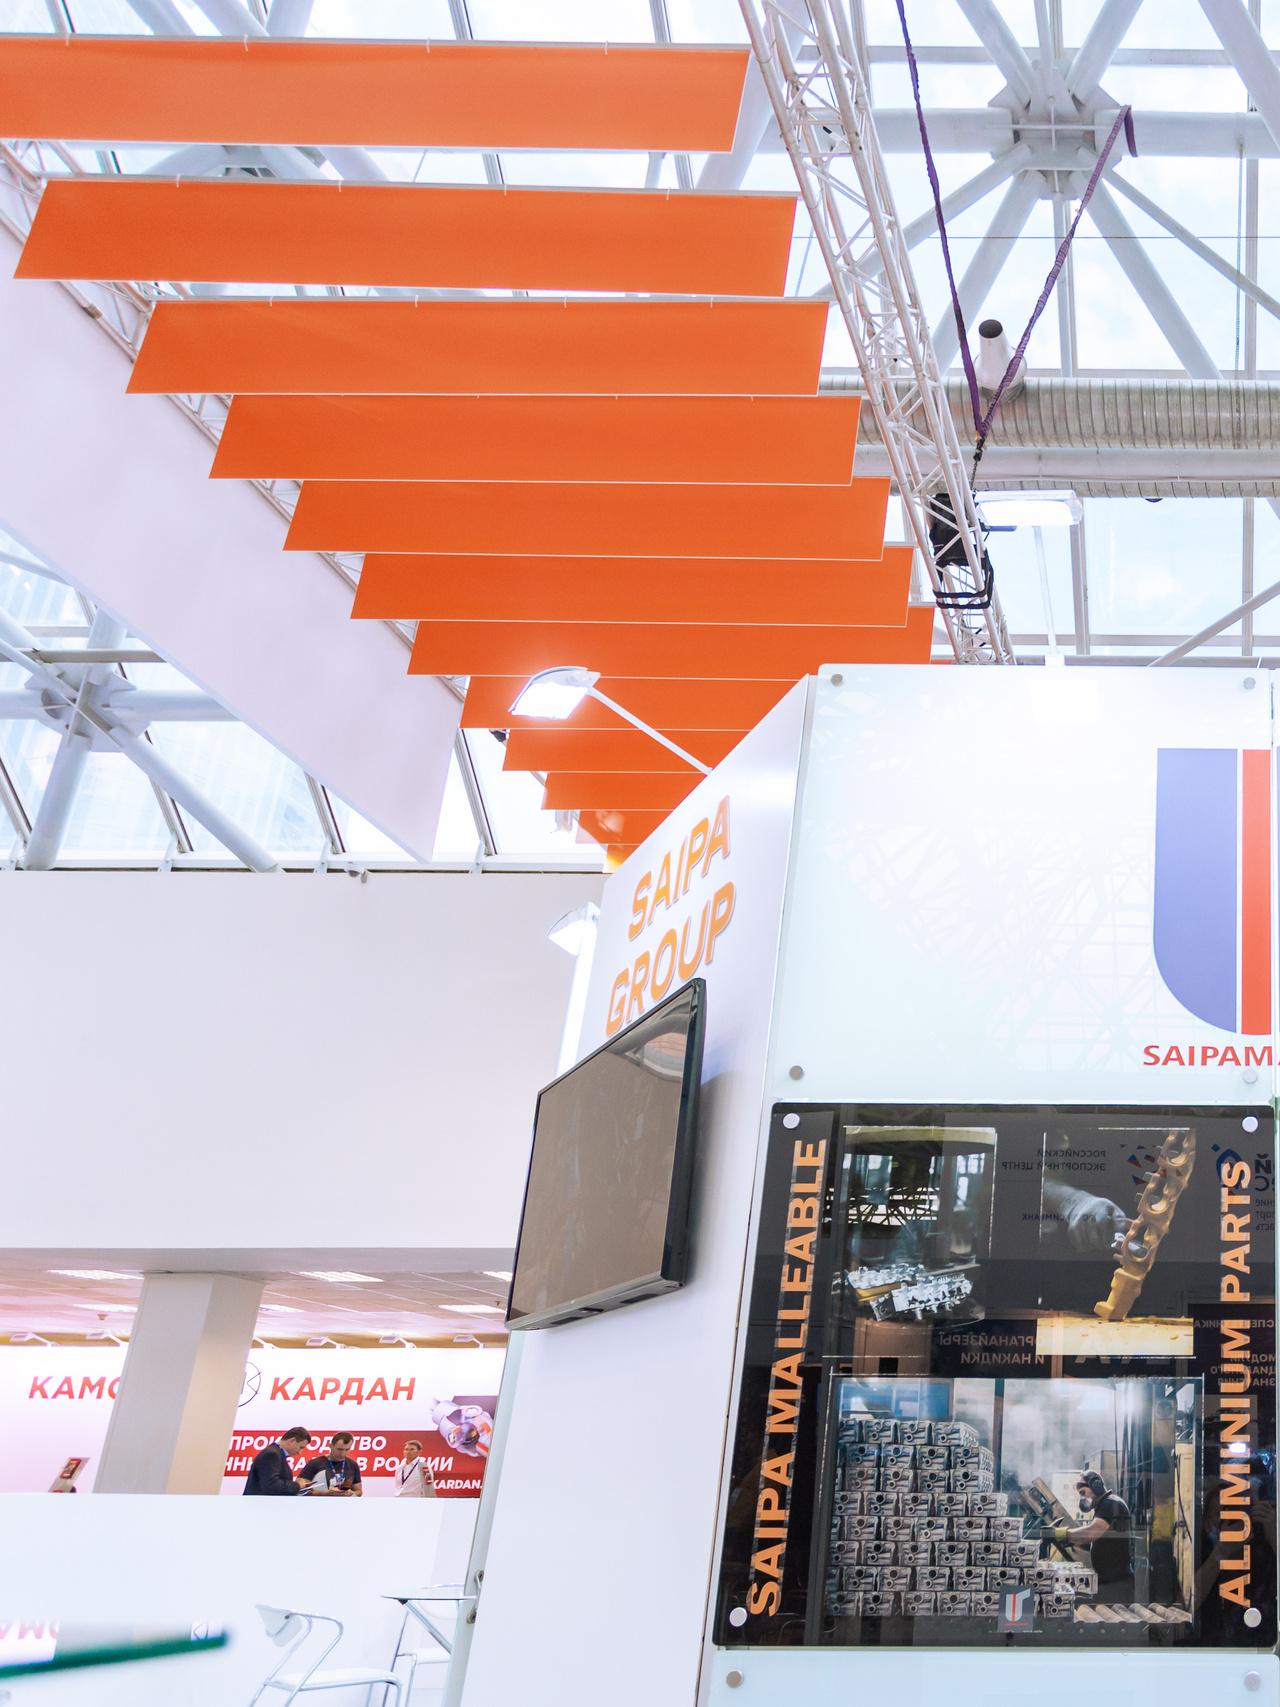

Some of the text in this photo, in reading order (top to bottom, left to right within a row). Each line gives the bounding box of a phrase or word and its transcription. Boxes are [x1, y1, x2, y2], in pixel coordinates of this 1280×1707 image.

[628, 795, 730, 941] SAIPA
[606, 881, 736, 1038] GROUP
[269, 1377, 417, 1406] КАРДАН
[747, 1138, 827, 1617] SAIPA MALLEABLE
[1220, 1160, 1252, 1608] ALUMINIUM PARTS
